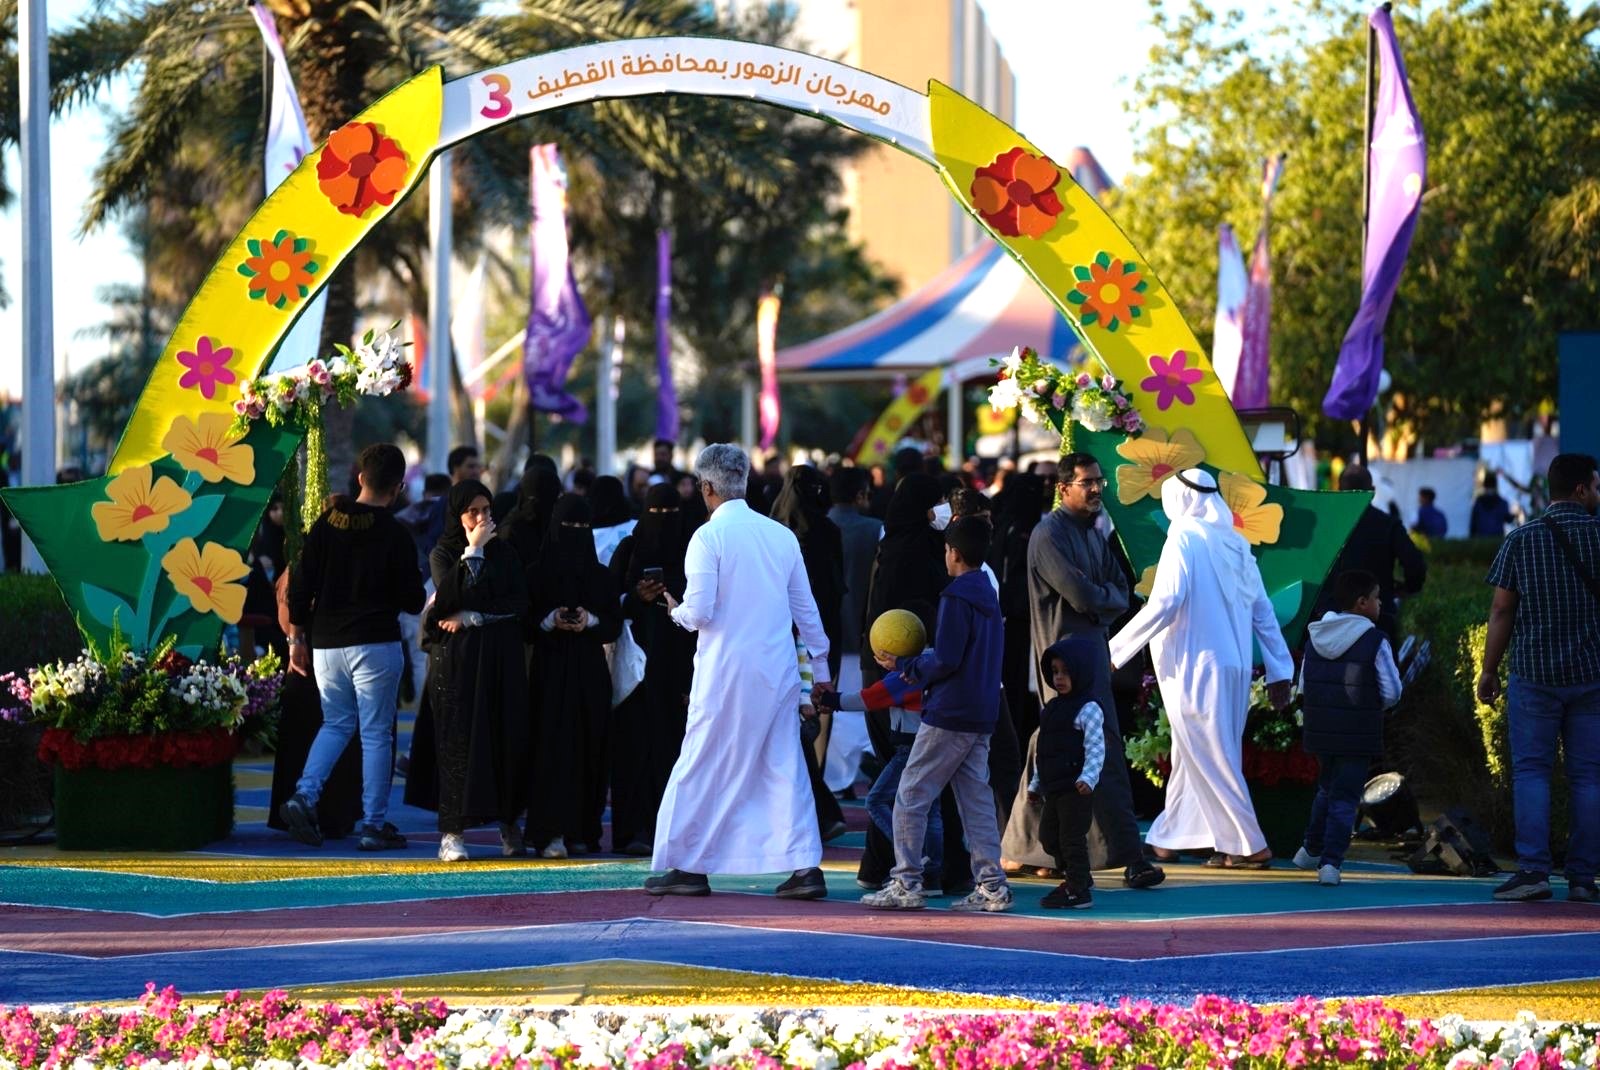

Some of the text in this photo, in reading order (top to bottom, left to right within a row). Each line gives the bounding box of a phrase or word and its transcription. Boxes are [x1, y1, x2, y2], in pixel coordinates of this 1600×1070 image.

[480, 53, 892, 120] مهرجان الزهور بمحافظة القطيف 3
